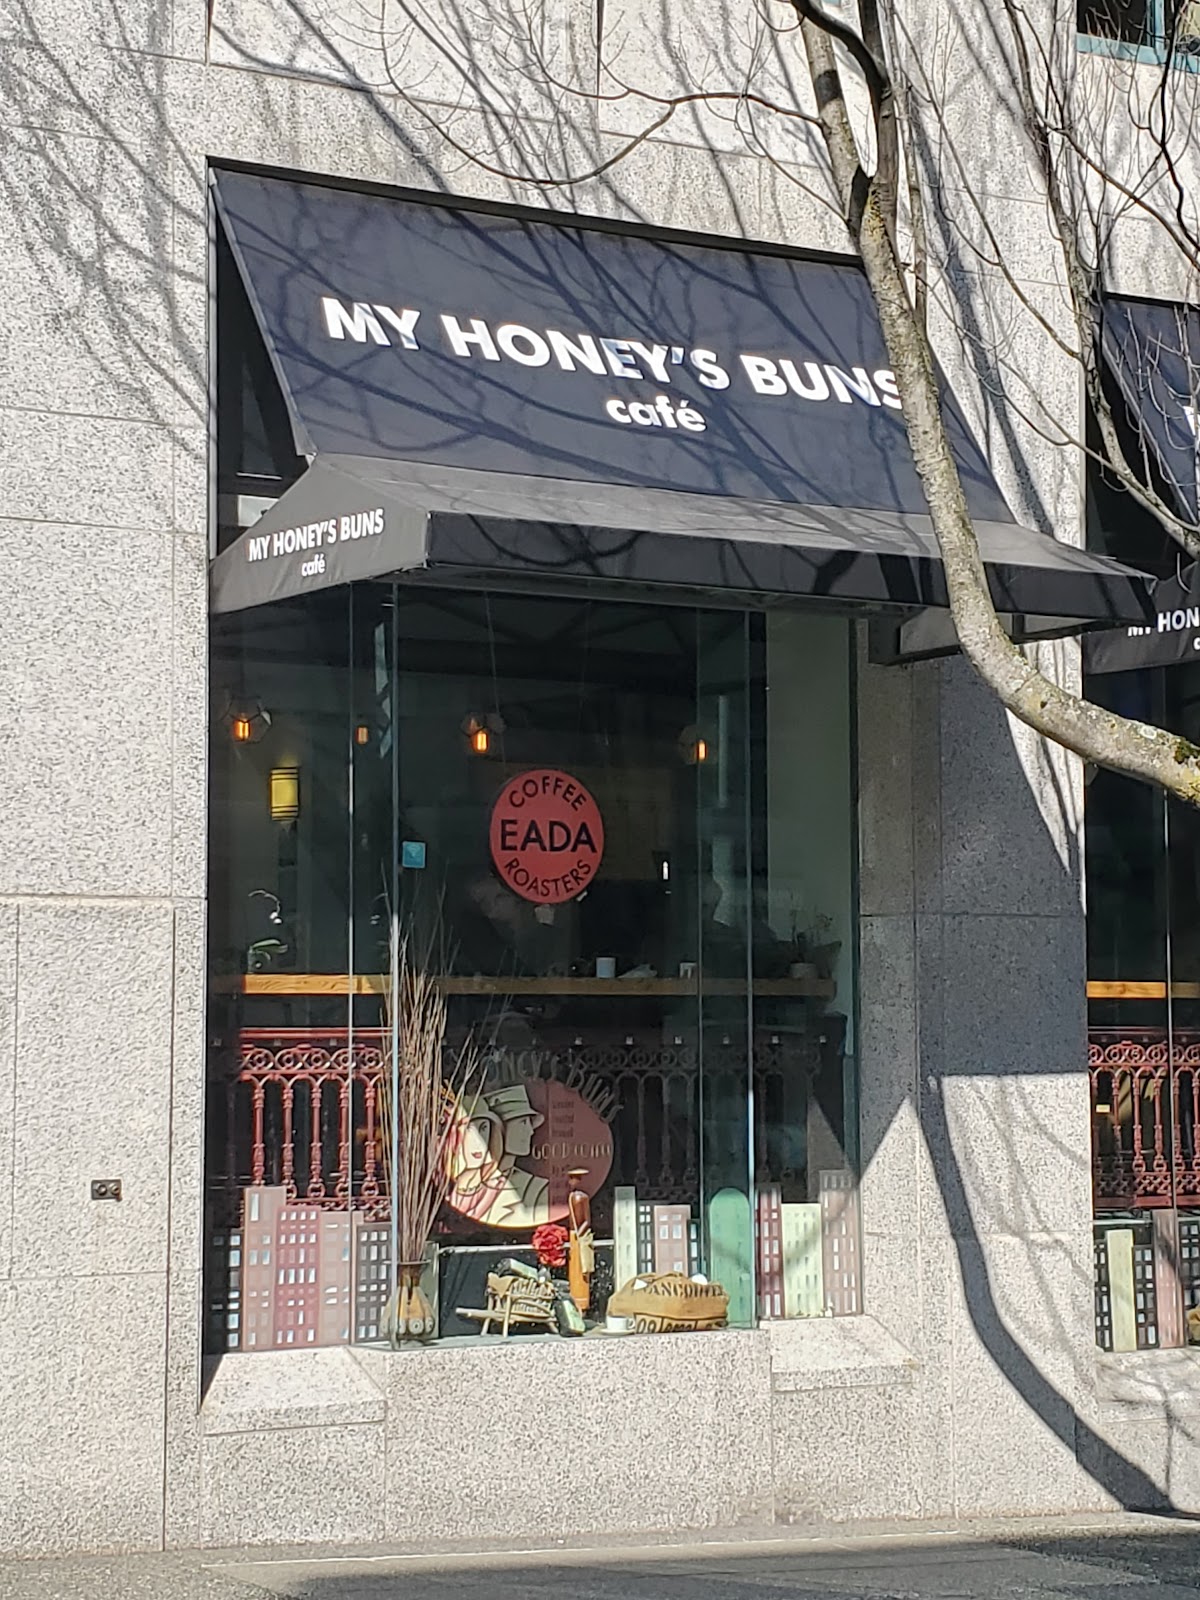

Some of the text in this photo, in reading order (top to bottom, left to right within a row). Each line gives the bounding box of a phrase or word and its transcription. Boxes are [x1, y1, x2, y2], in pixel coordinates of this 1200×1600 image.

[320, 297, 902, 410] MY HONEY'S BUNS
[605, 394, 707, 433] café
[248, 508, 385, 562] MY HONEY'S BUNS
[301, 553, 326, 577] café
[509, 776, 587, 811] COFFEE
[501, 819, 597, 854] EADA
[504, 858, 592, 897] ROASTERS
